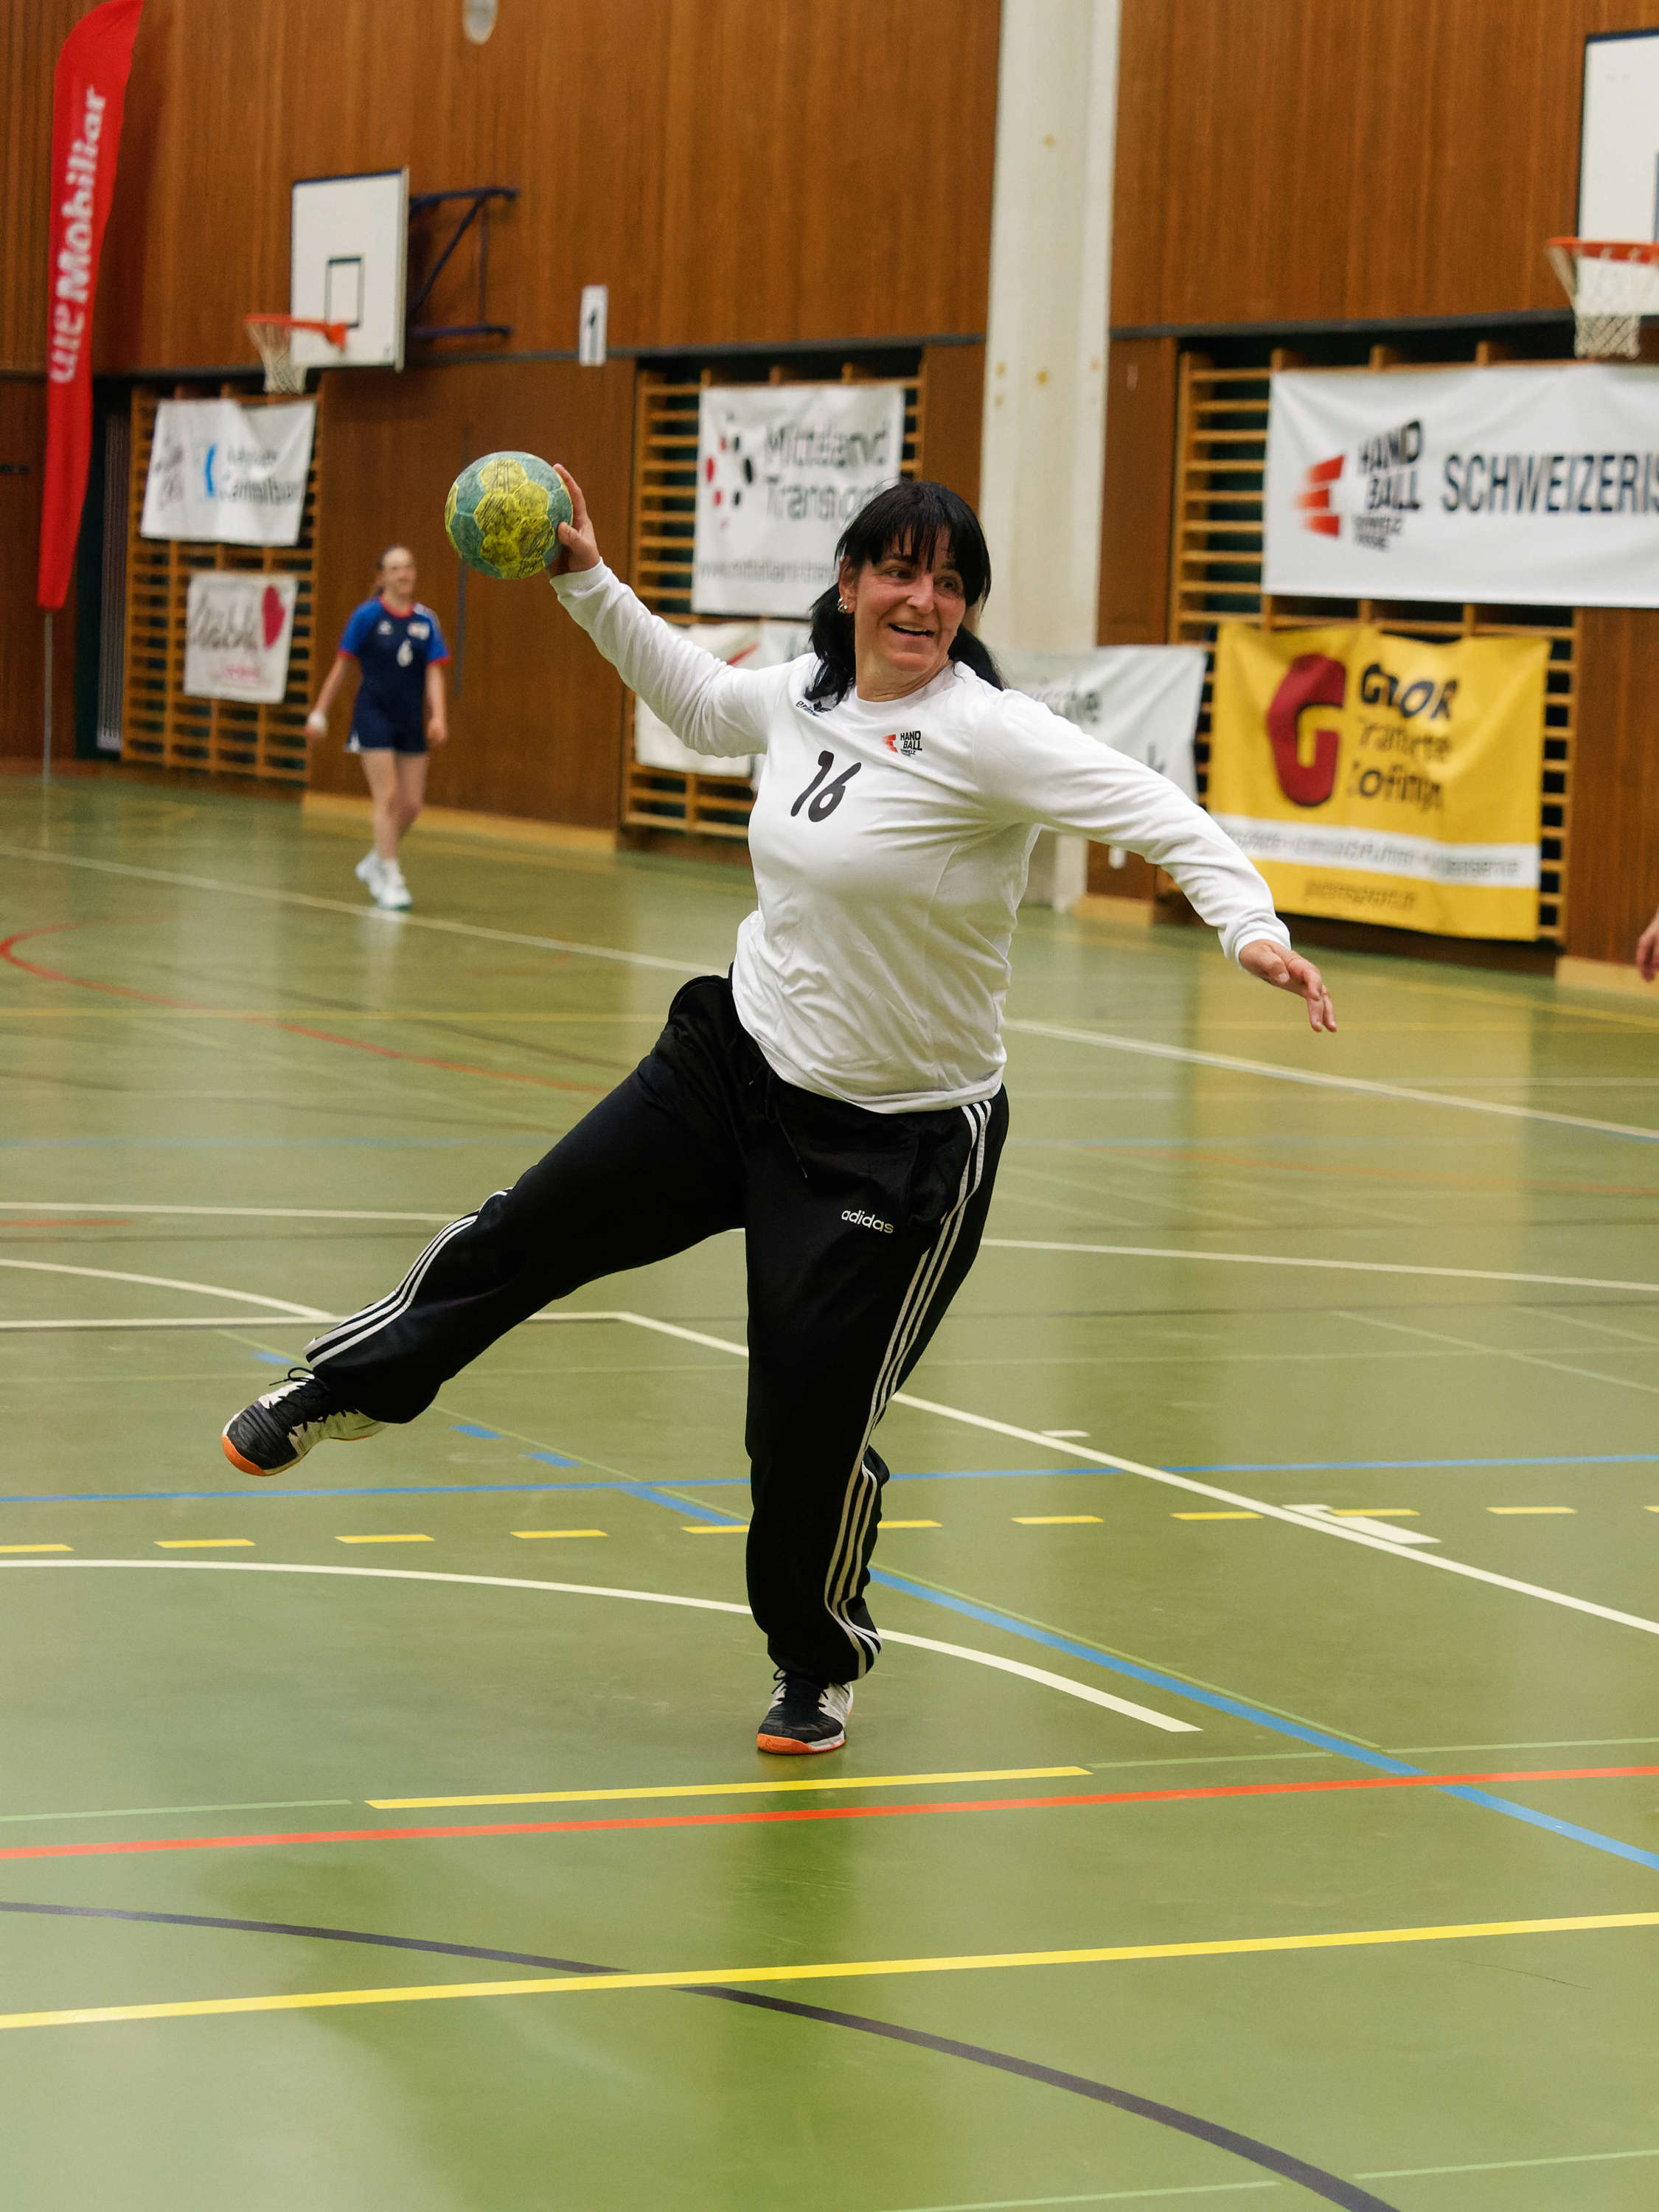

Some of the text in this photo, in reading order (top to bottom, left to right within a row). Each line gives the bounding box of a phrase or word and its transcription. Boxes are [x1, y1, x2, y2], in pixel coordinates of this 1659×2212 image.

[56, 85, 106, 304] Mobiliar
[900, 730, 922, 741] HAND
[902, 740, 923, 751] BALL
[790, 750, 862, 823] 16
[841, 1209, 894, 1234] adidas
